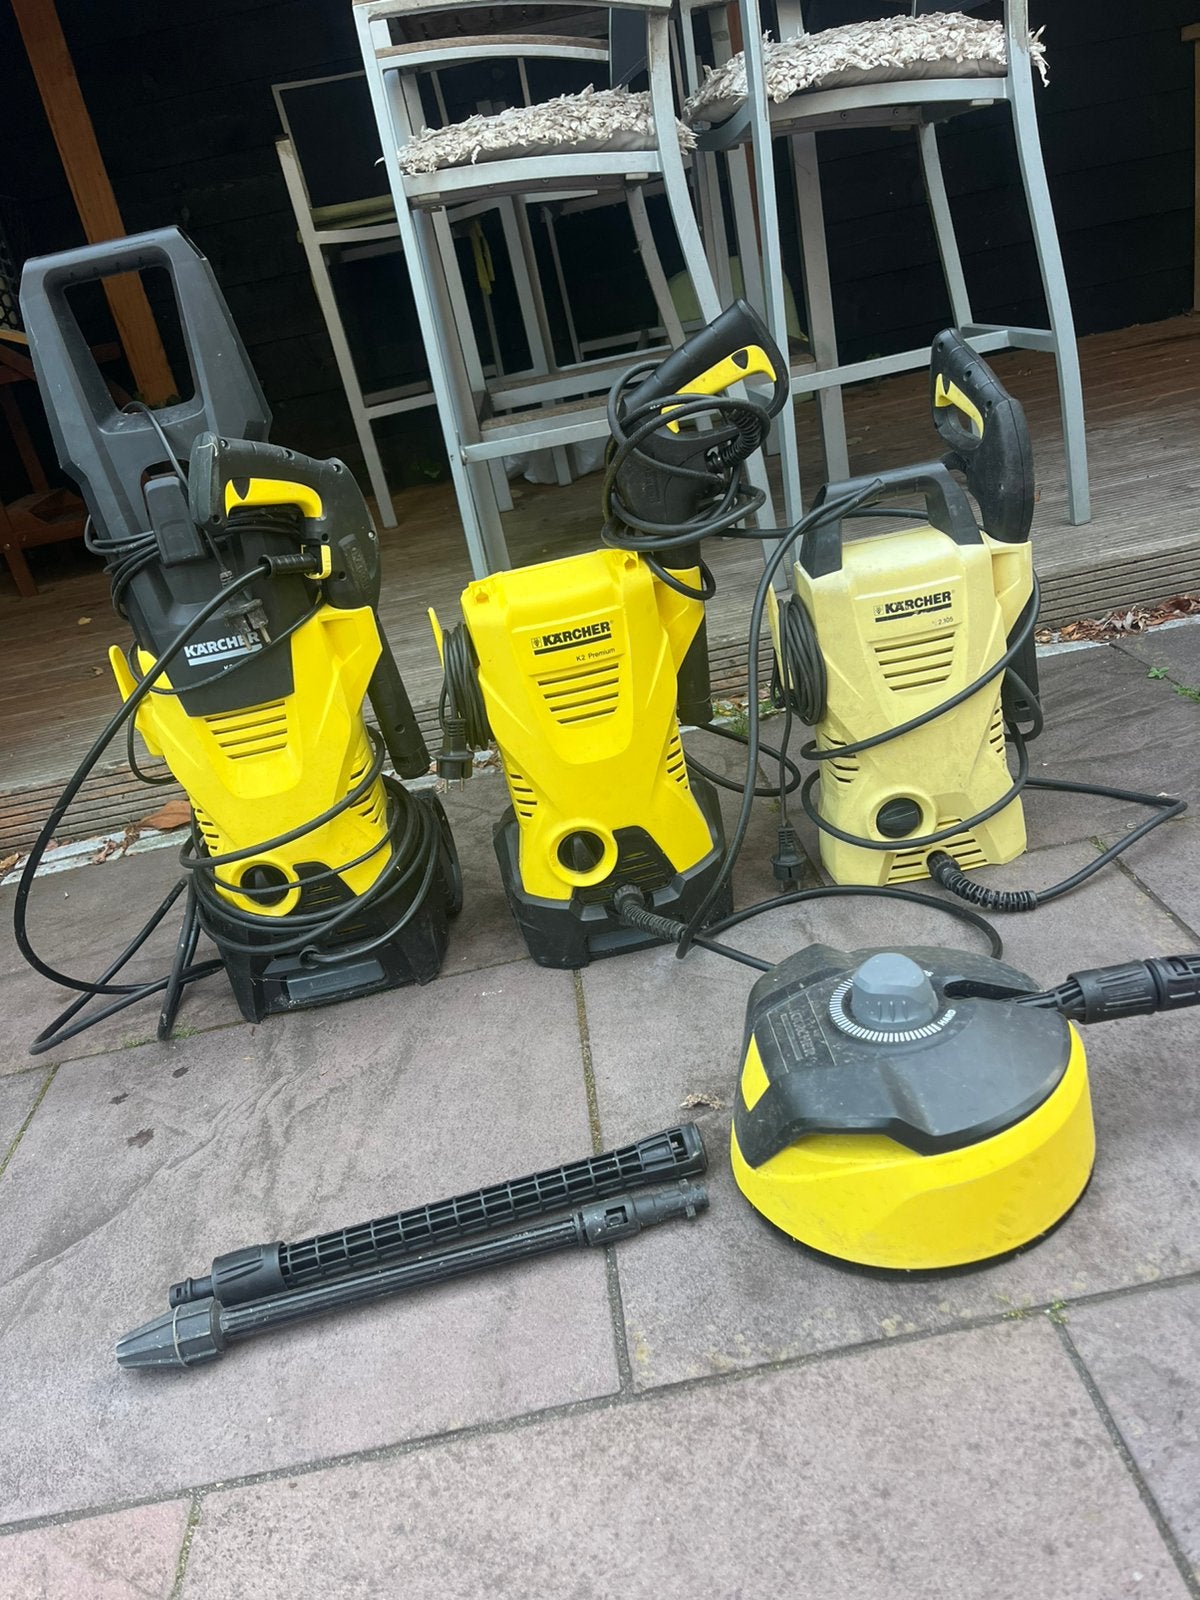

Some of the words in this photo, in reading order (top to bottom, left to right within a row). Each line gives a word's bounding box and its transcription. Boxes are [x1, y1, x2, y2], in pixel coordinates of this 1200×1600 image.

[884, 590, 951, 615] KÄRCHER
[542, 621, 611, 646] KÄRCHER
[575, 654, 586, 662] K2
[588, 647, 616, 659] Premium
[938, 1009, 957, 1027] HARD
